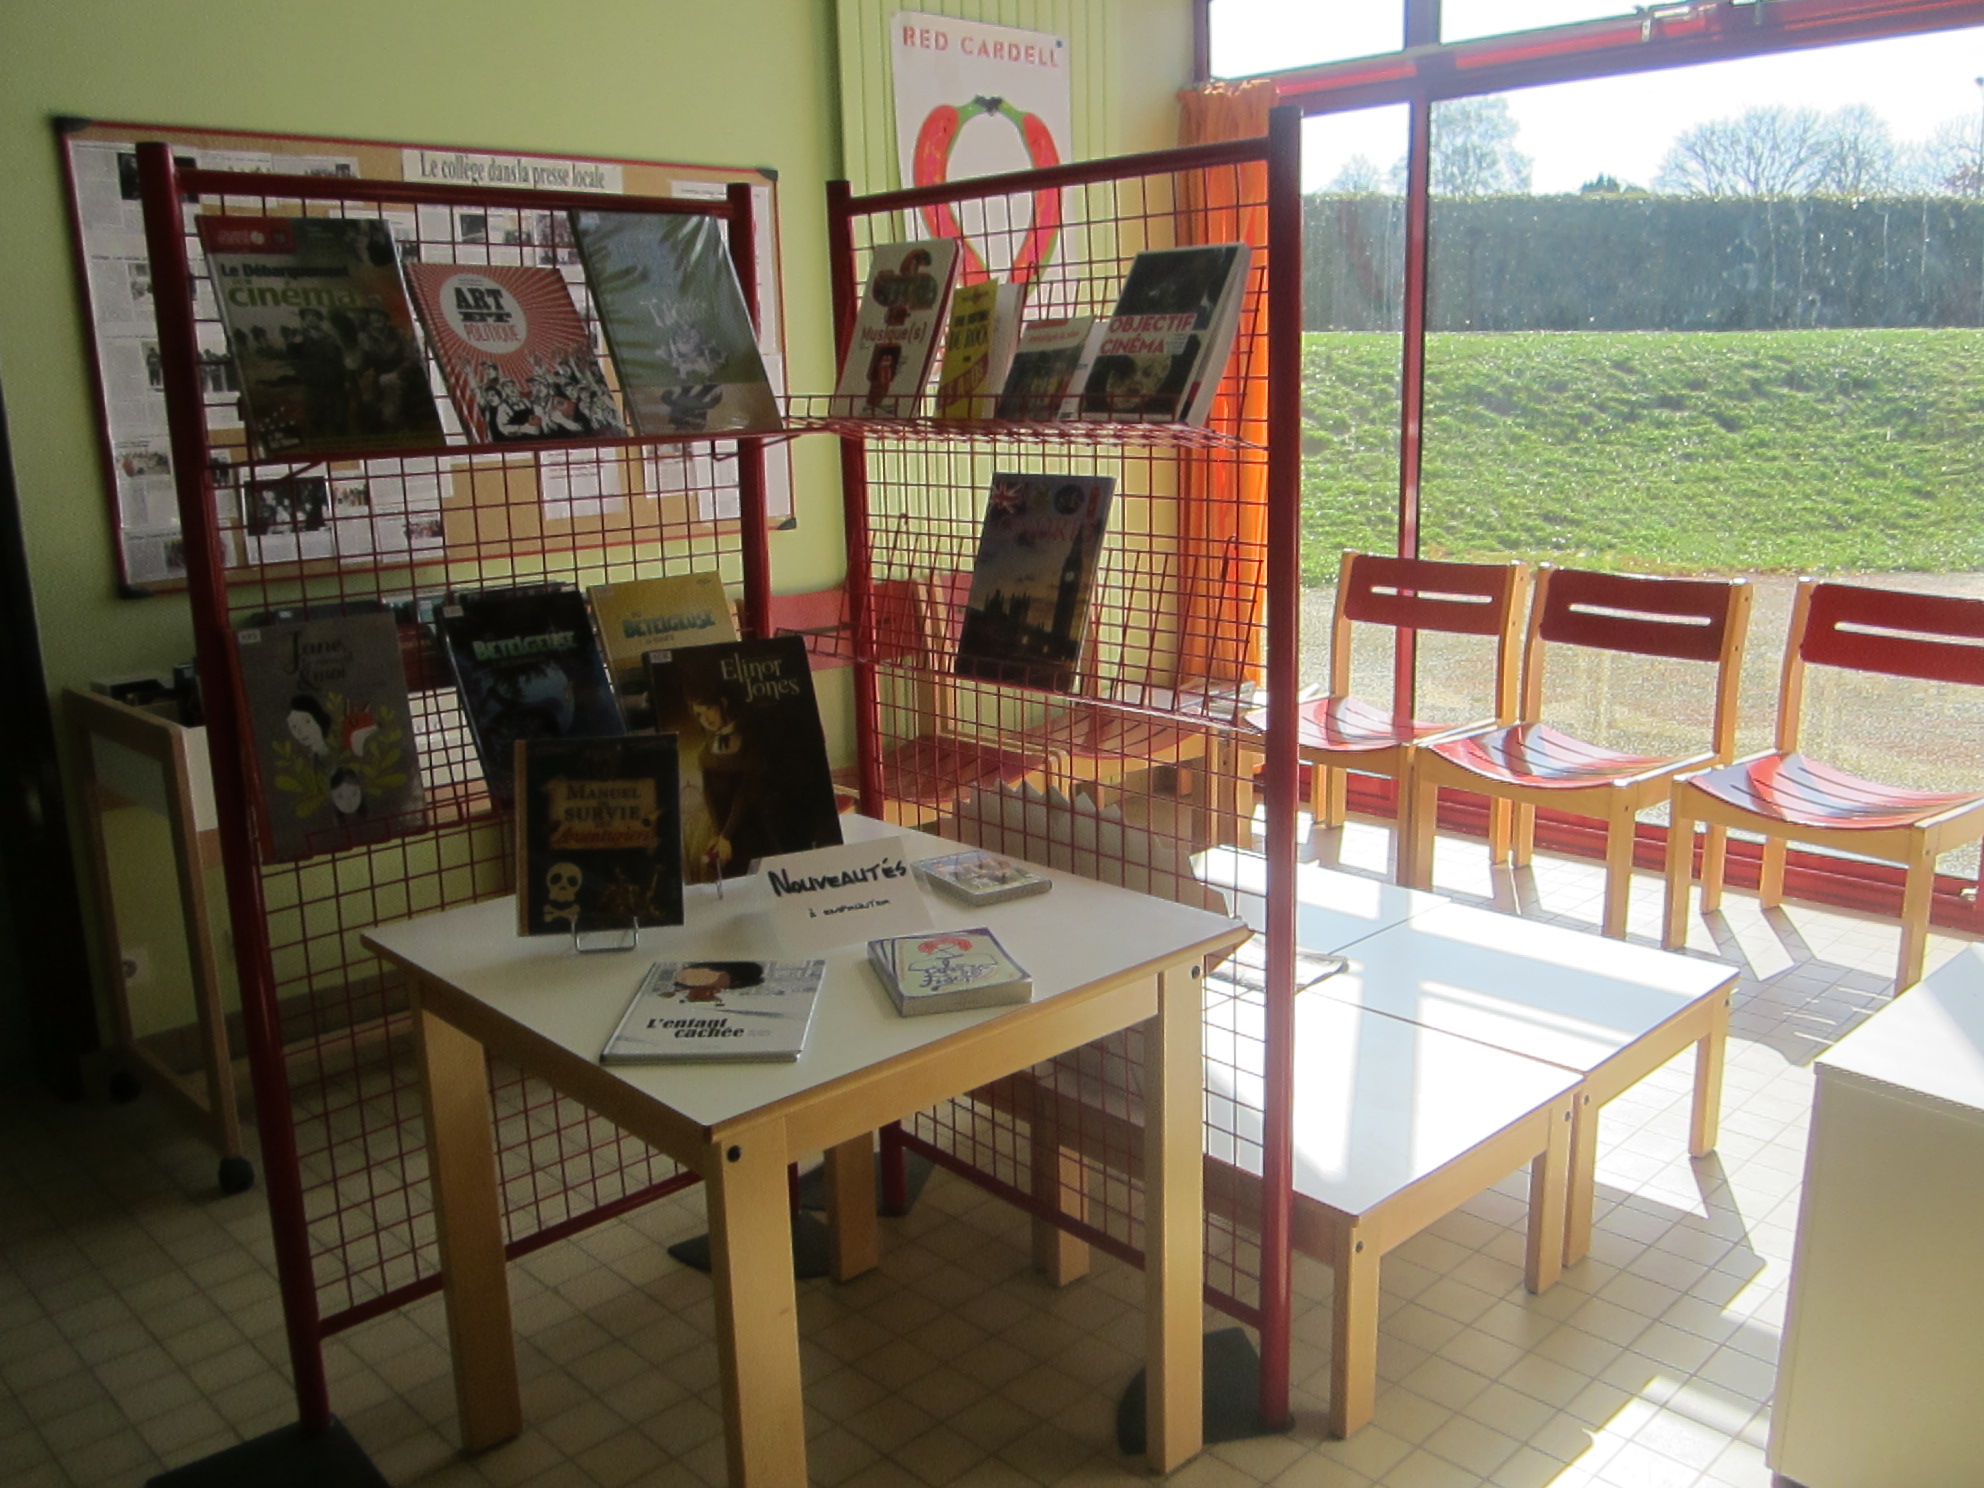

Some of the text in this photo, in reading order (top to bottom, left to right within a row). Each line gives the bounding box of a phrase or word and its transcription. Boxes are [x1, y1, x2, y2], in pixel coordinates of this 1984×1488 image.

[903, 26, 1059, 67] RED CARDELL
[420, 151, 437, 177] Le
[441, 154, 484, 185] collège
[533, 165, 569, 190] presse
[572, 163, 605, 189] locale
[221, 263, 349, 280] Le Débarquement
[227, 279, 357, 307] cinéma
[454, 287, 506, 311] ART
[861, 321, 927, 344] Musique(s)
[1109, 312, 1195, 333] OBJECTIF
[1101, 332, 1165, 354] CINÉMA
[720, 652, 782, 683] Elinor
[745, 677, 800, 703] Jones
[564, 805, 641, 822] SURVIE
[646, 1018, 728, 1030] L'enfant
[674, 1026, 745, 1039] cachée
